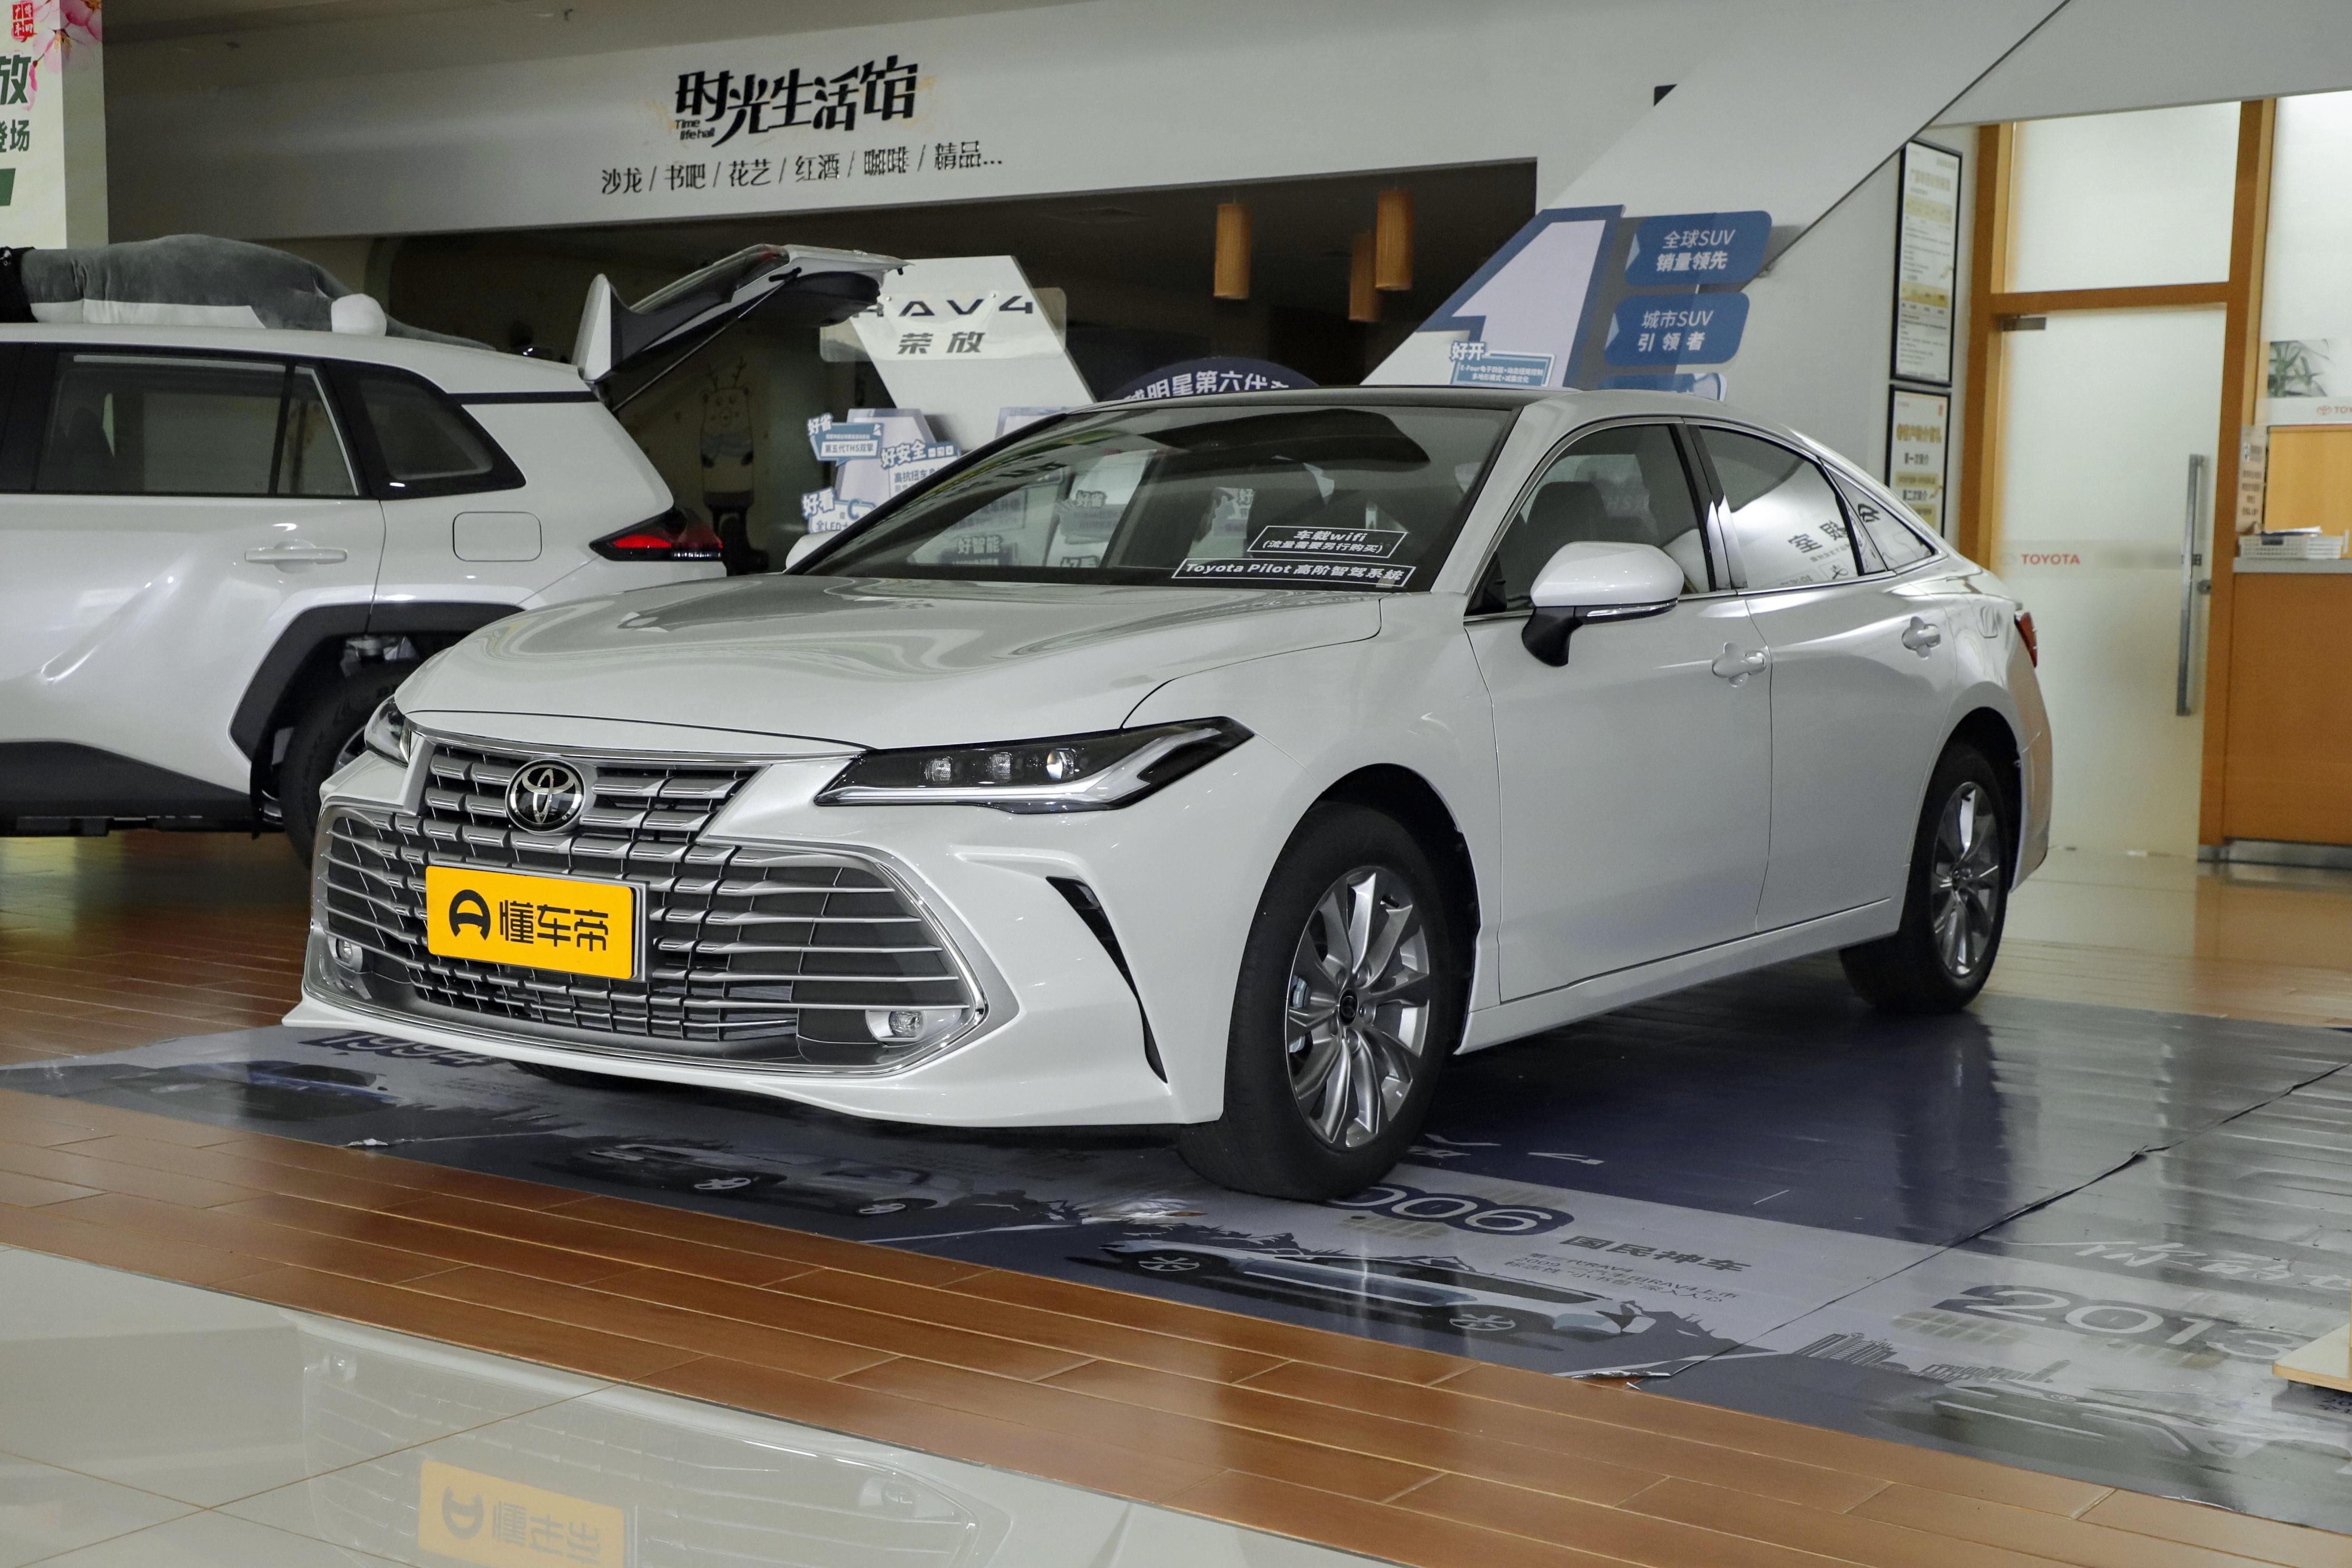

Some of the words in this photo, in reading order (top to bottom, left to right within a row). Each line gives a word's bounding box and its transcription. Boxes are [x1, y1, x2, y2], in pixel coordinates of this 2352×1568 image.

[675, 55, 918, 148] 时光生活馆
[602, 168, 642, 194] 沙龙
[664, 163, 705, 190] 书吧
[728, 159, 771, 187] 花艺
[795, 153, 840, 182] 红酒
[1662, 230, 1736, 249] 全球SUV
[1655, 251, 1729, 273] 销量领先
[1641, 310, 1714, 330] 城市SUV
[897, 331, 987, 355] 荣放
[1451, 341, 1485, 360] 好开
[1638, 332, 1707, 352] 引领者
[881, 440, 927, 468] 好安全
[802, 487, 835, 517] 好看
[1262, 540, 1383, 554] (流量需要另行购买)
[1293, 530, 1368, 542] 车载wifi
[2021, 554, 2081, 565] TOYOTA
[1186, 564, 1244, 575] Toyota
[1247, 564, 1292, 574] Pilot
[1294, 564, 1406, 581] 高阶智驾系统
[499, 899, 609, 952] 懂车帝
[1559, 1235, 1752, 1272] 国民神车
[1967, 1289, 2304, 1363] 2013
